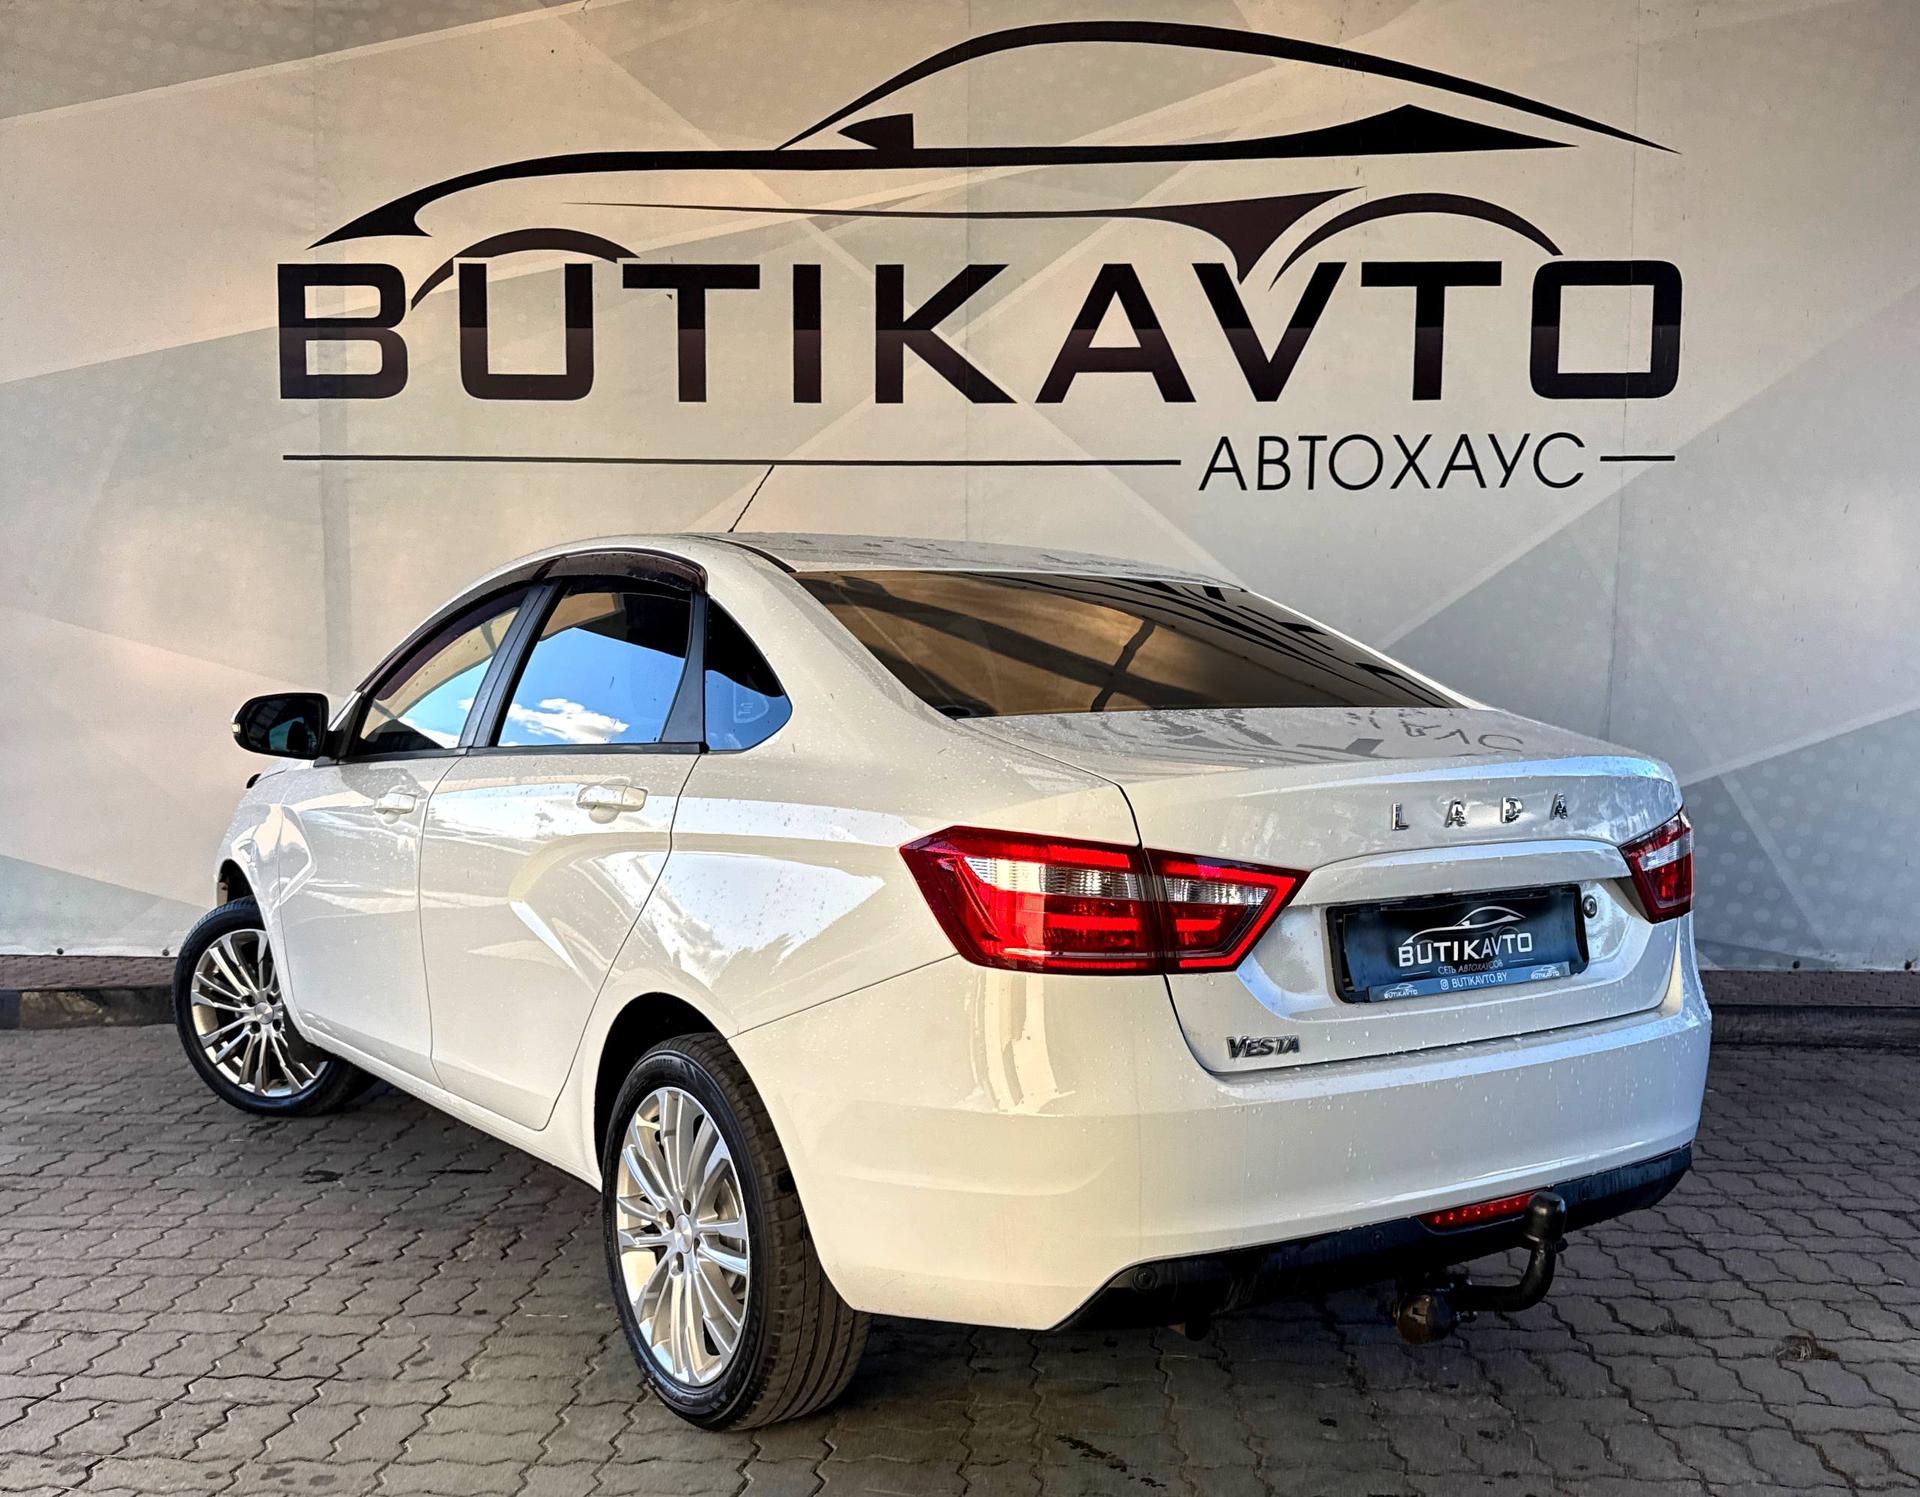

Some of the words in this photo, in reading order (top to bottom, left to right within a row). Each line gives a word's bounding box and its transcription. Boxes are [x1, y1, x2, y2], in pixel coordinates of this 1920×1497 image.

[278, 260, 1683, 404] BUTIKAVTO
[1198, 432, 1586, 491] АВТОХАУС
[1391, 792, 1568, 831] LADA
[1398, 932, 1533, 967] BUTIKAVTO
[1437, 965, 1456, 975] СЕТЬ
[1226, 1034, 1301, 1059] VESTA
